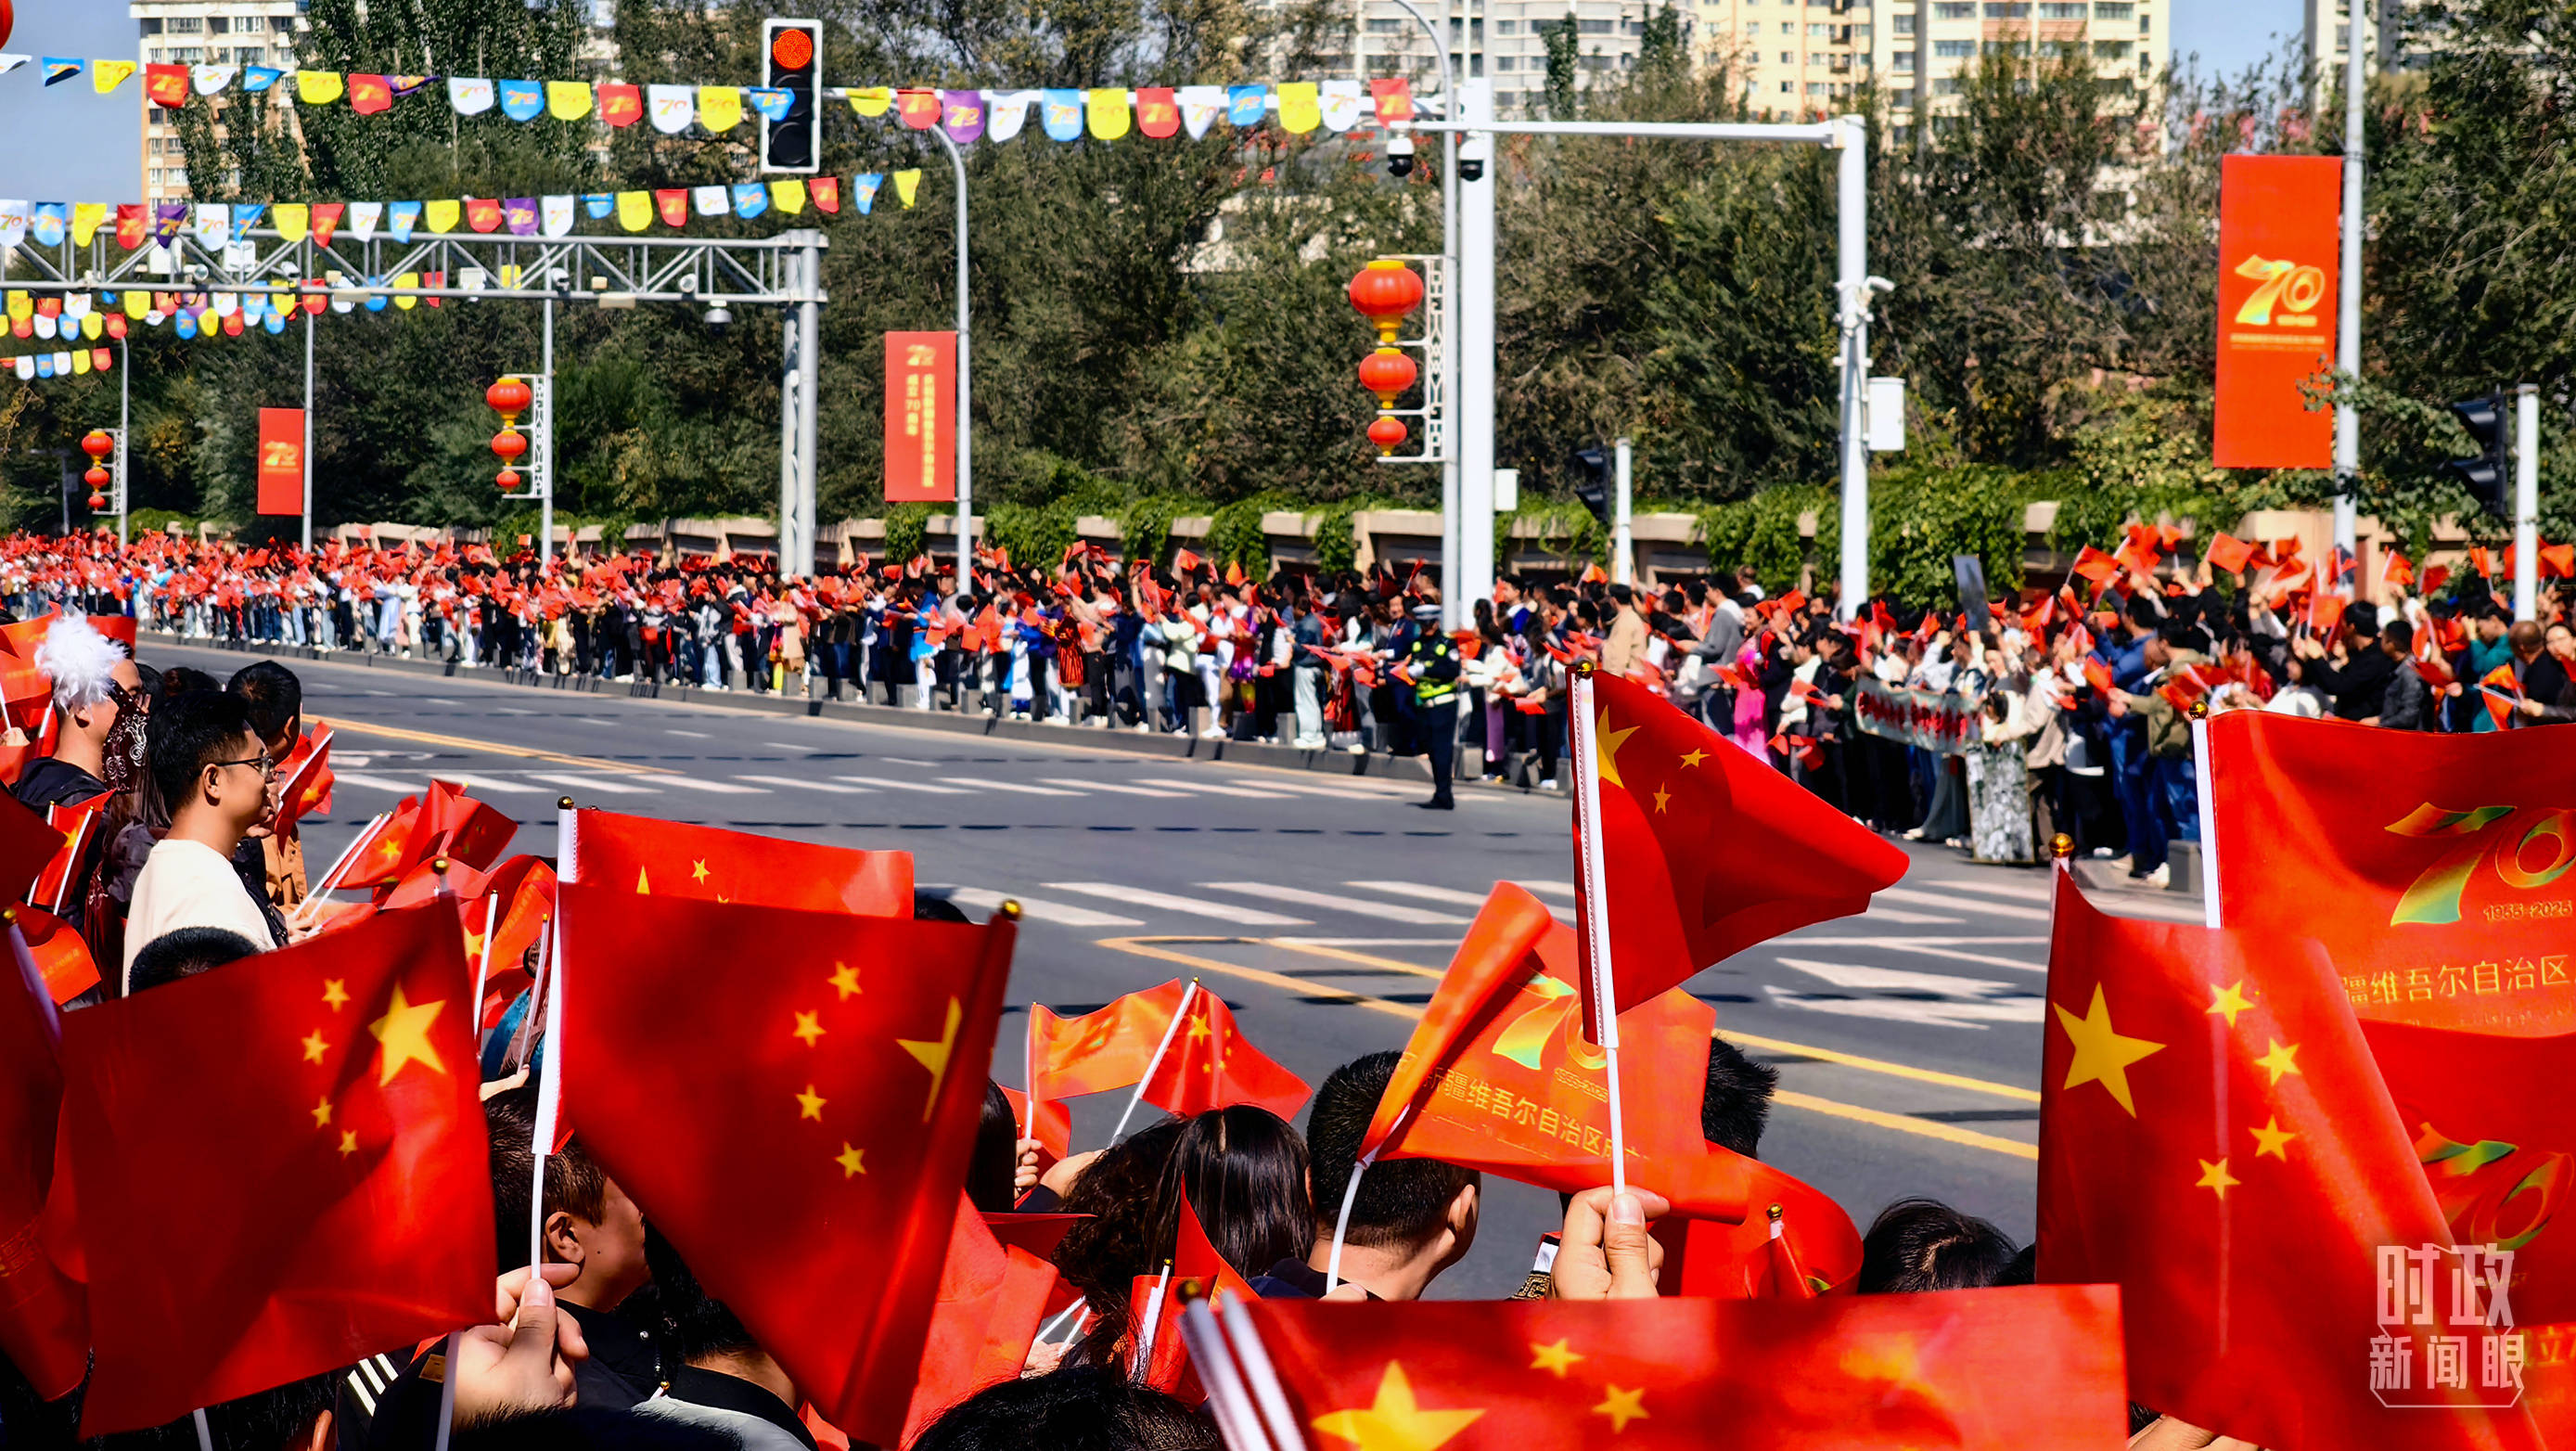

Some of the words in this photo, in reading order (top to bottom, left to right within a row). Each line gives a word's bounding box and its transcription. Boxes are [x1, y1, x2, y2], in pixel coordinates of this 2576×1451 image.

[659, 98, 687, 116] 70
[949, 106, 980, 127] 70
[1049, 104, 1079, 124] 70
[1, 213, 22, 230] 70
[200, 218, 224, 234] 70
[2234, 254, 2326, 326] 70
[2384, 802, 2576, 927] 70
